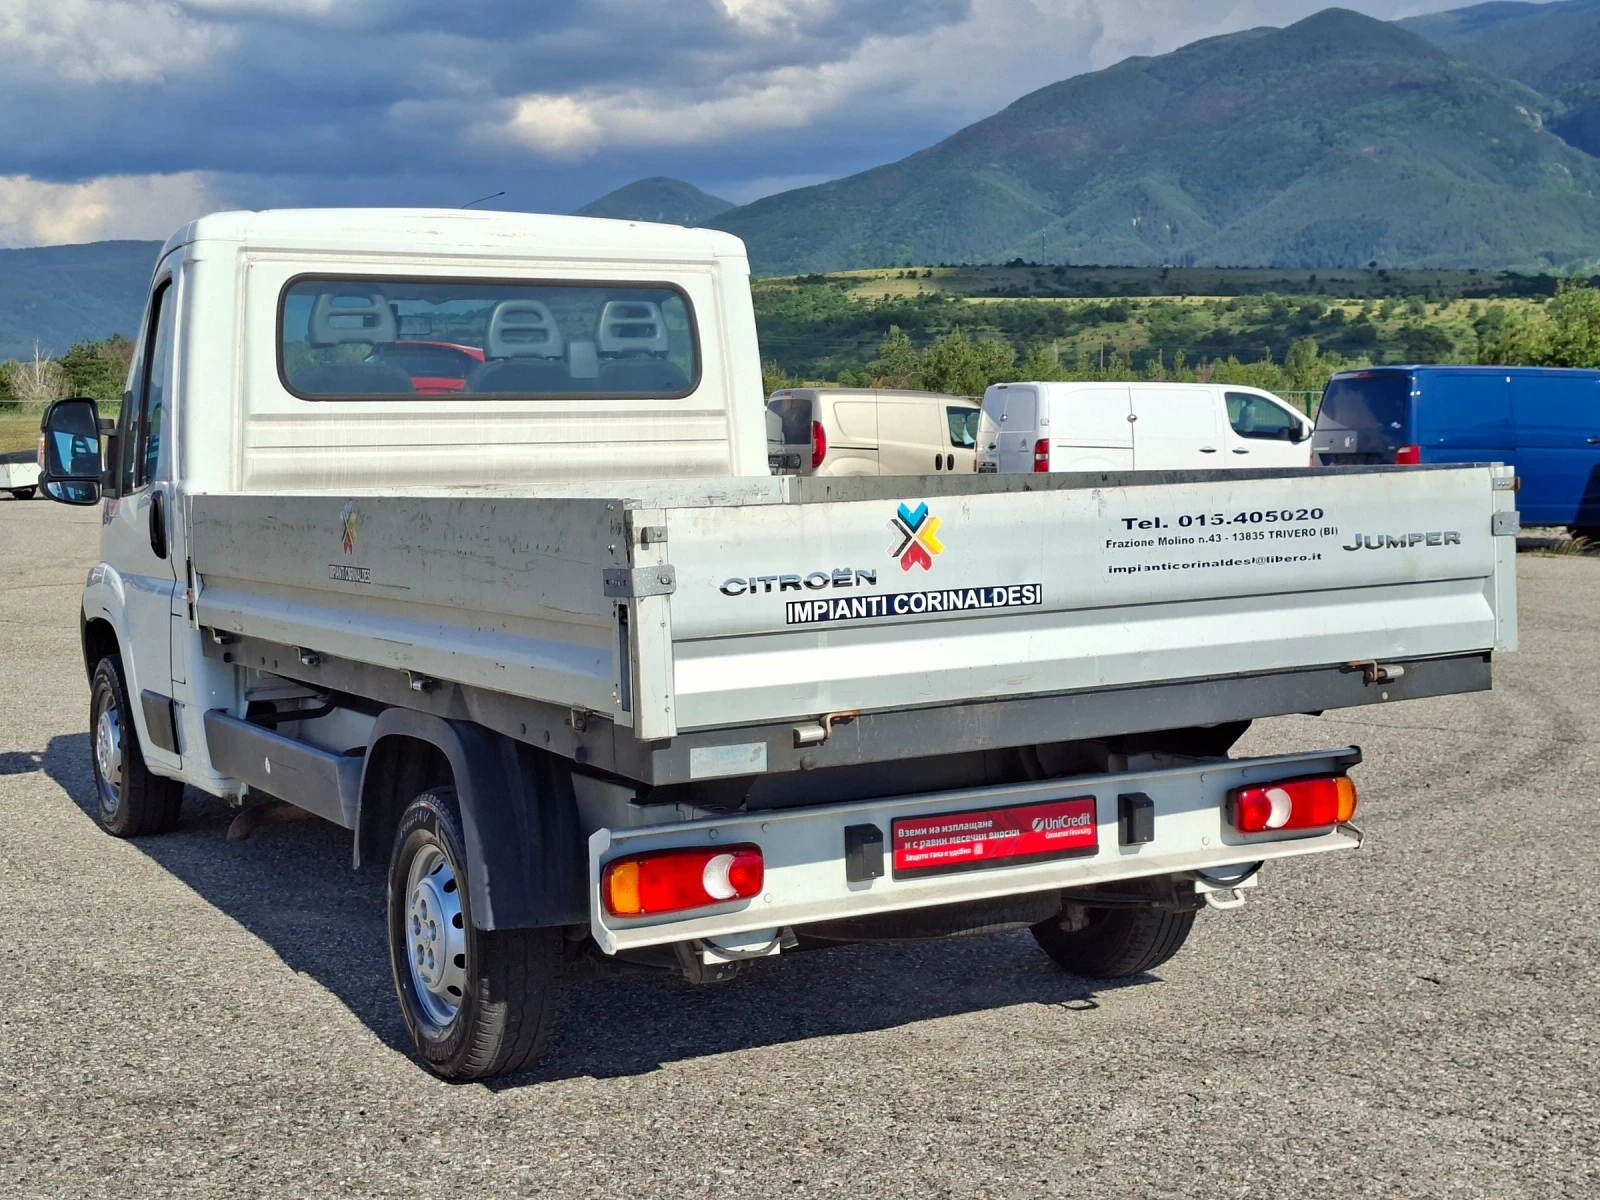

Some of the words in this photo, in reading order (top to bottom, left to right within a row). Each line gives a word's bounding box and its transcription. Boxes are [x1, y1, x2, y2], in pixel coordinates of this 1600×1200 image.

[1121, 516, 1169, 530] Tel.
[1178, 507, 1324, 528] 015.405020
[1106, 538, 1155, 549] Frazione
[1158, 535, 1195, 546] Molino
[1198, 533, 1223, 544] n.43
[1232, 531, 1265, 541] 13835
[1268, 528, 1316, 539] TRIVERO
[1320, 526, 1338, 538] (BI)
[1343, 530, 1461, 552] JUMPER
[719, 567, 877, 596] CITROËN
[787, 596, 887, 623] IMPIANTI
[893, 584, 1042, 614] CORINALDESI
[898, 827, 927, 838] Вземи
[929, 826, 940, 834] на
[942, 820, 993, 833] изплащане
[1045, 812, 1091, 830] UniCredit
[905, 841, 911, 849] и
[913, 840, 918, 848] с
[920, 837, 947, 849] равни
[949, 832, 987, 844] месечни
[988, 828, 1020, 839] вноски
